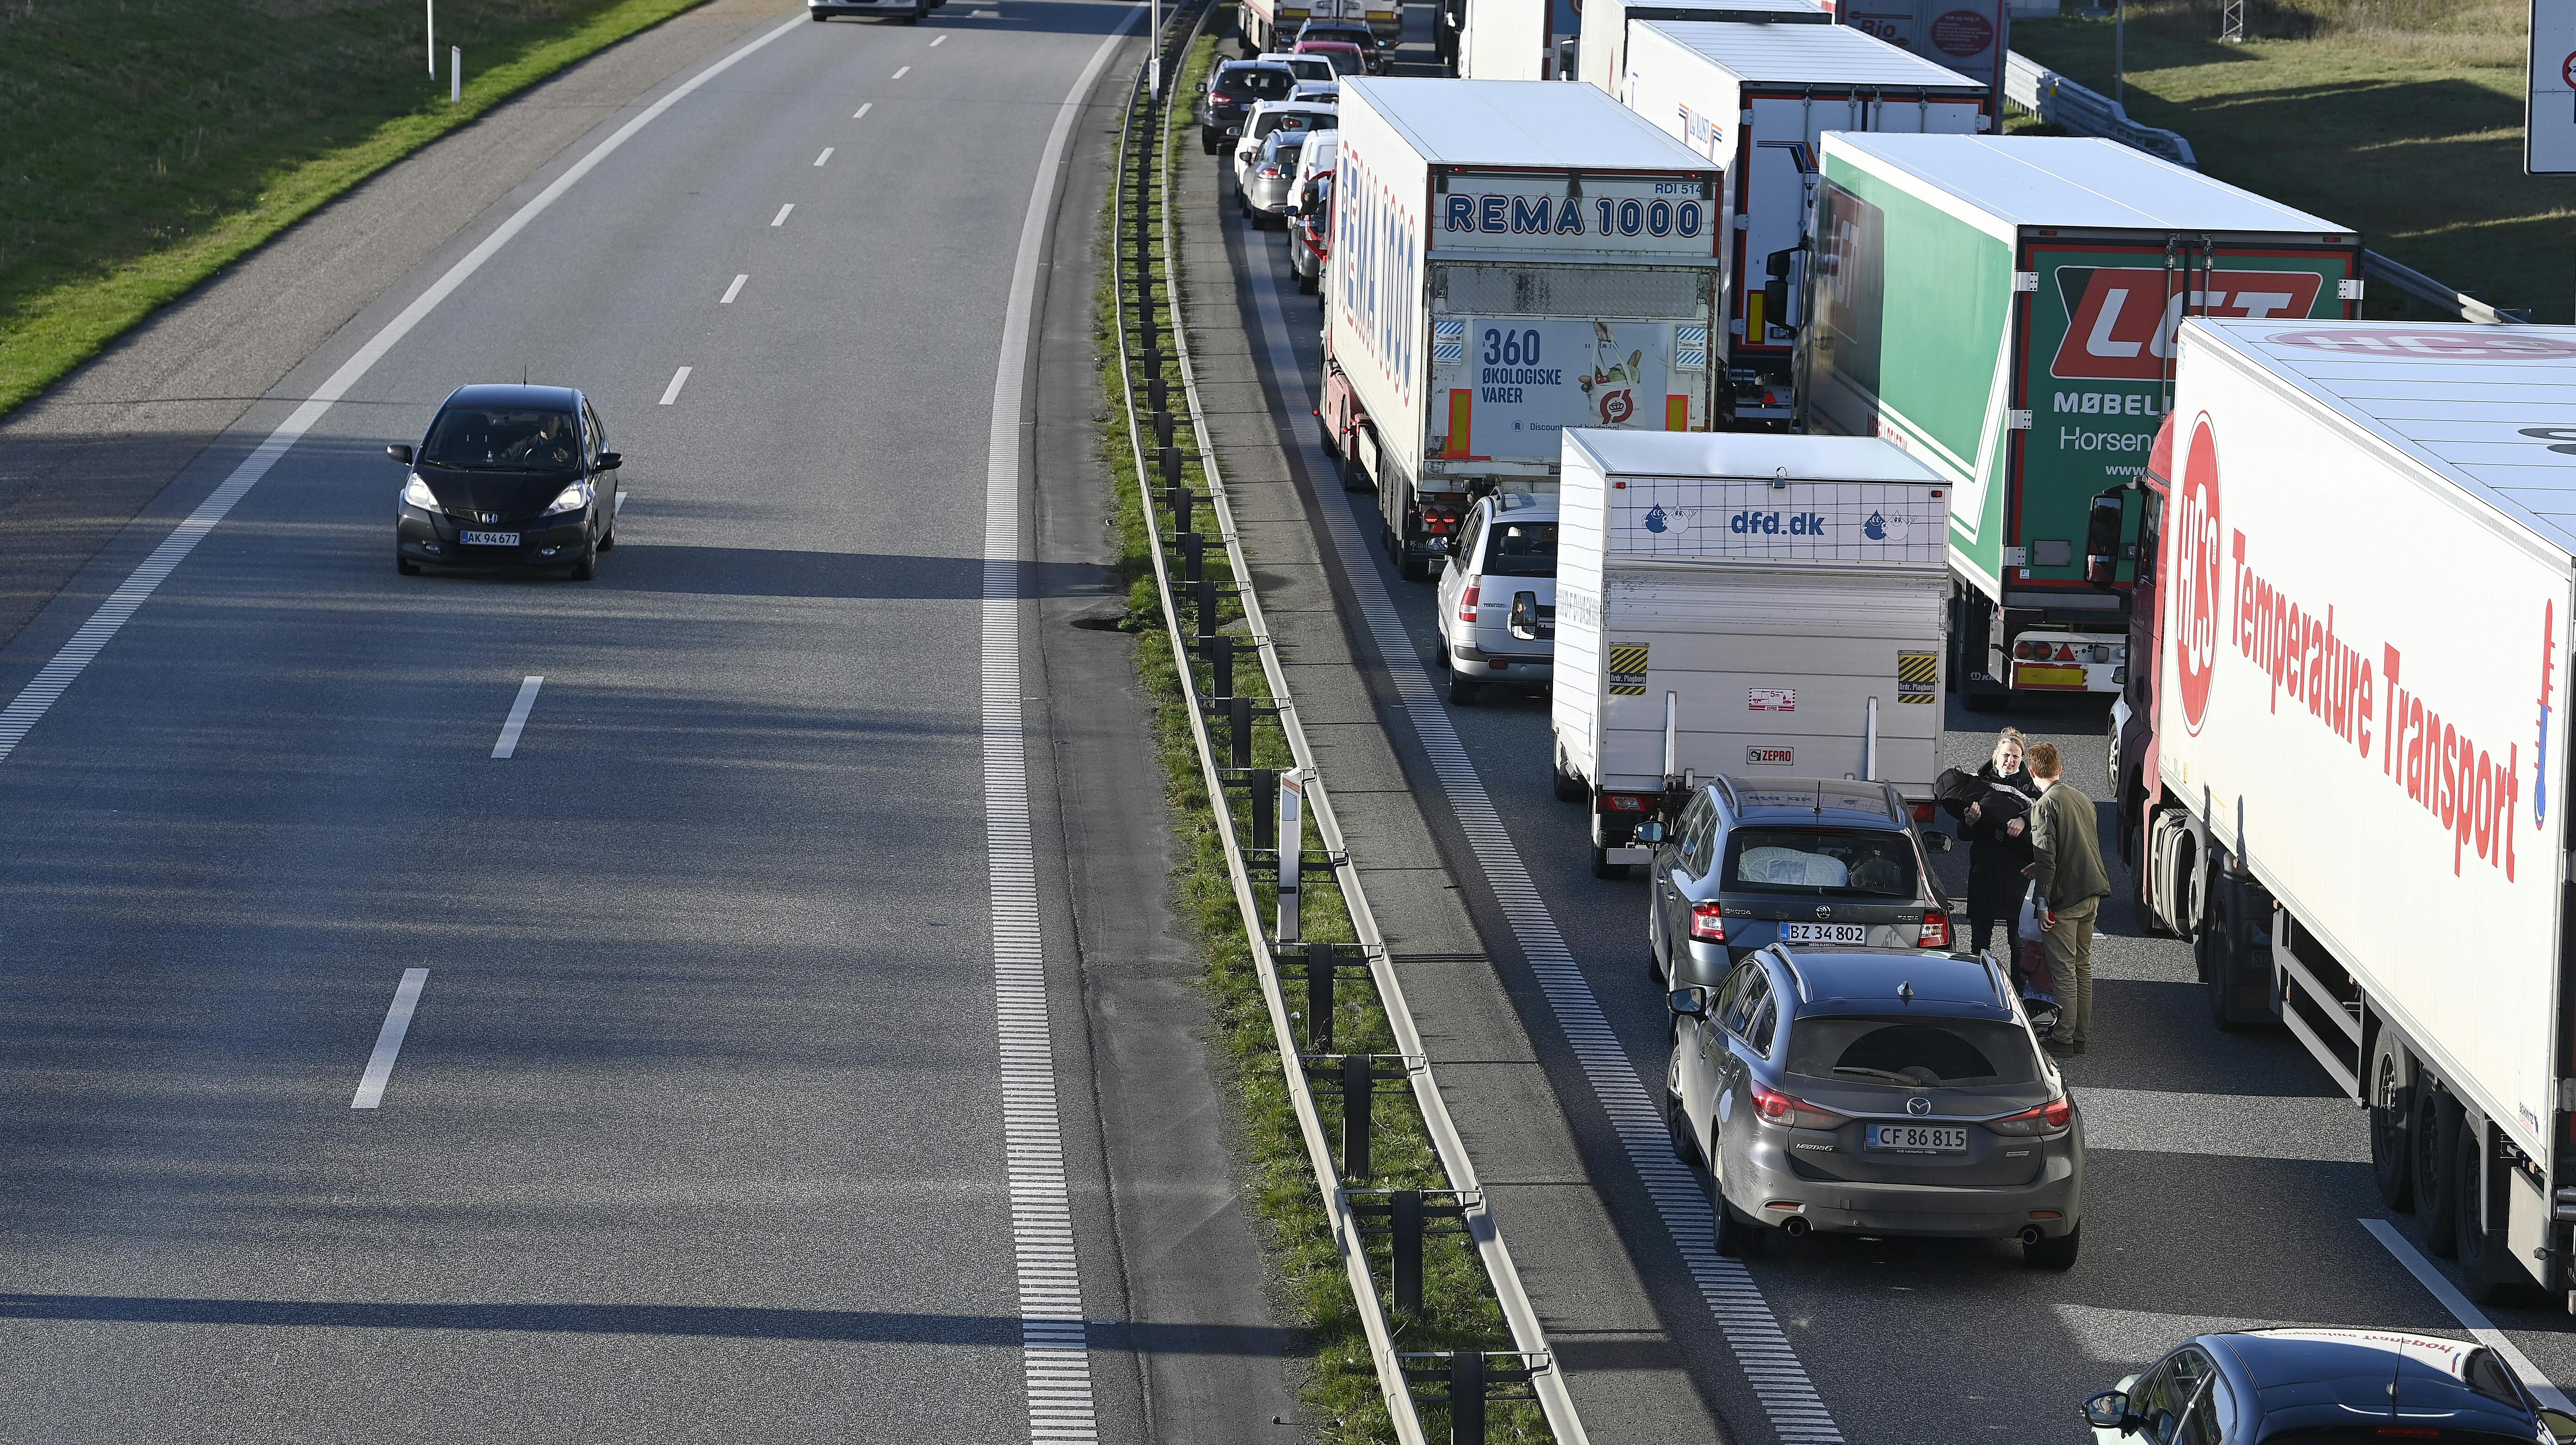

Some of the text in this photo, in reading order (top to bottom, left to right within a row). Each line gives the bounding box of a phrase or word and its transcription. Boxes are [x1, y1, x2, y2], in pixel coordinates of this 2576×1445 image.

[1861, 19, 1896, 37] Bio
[1655, 184, 1677, 194] RDI
[1444, 193, 1703, 238] REMA 1000
[1338, 140, 1414, 407] REMA 1000
[1484, 329, 1541, 366] 360
[1482, 368, 1561, 385] ØKOLOGISKE
[1482, 387, 1523, 403] VARER
[2060, 426, 2158, 452] Horsen
[1731, 511, 1825, 535] dfd.dk
[468, 533, 481, 542] AK
[484, 533, 496, 543] 94
[499, 534, 518, 544] 677
[2177, 482, 2217, 676] HCS
[1624, 675, 1646, 683] Plagborg
[1913, 683, 1934, 692] Plagborg
[2232, 527, 2518, 883] Temperature Transport
[1762, 750, 1791, 762] ZEPRO
[1790, 925, 1810, 939] BZ
[1814, 926, 1832, 940] 34
[1836, 926, 1863, 941] 802
[2519, 1102, 2533, 1125] SCHMITZ
[1880, 1128, 1902, 1144] CF
[1907, 1129, 1928, 1145] 86
[1933, 1131, 1964, 1147] 815
